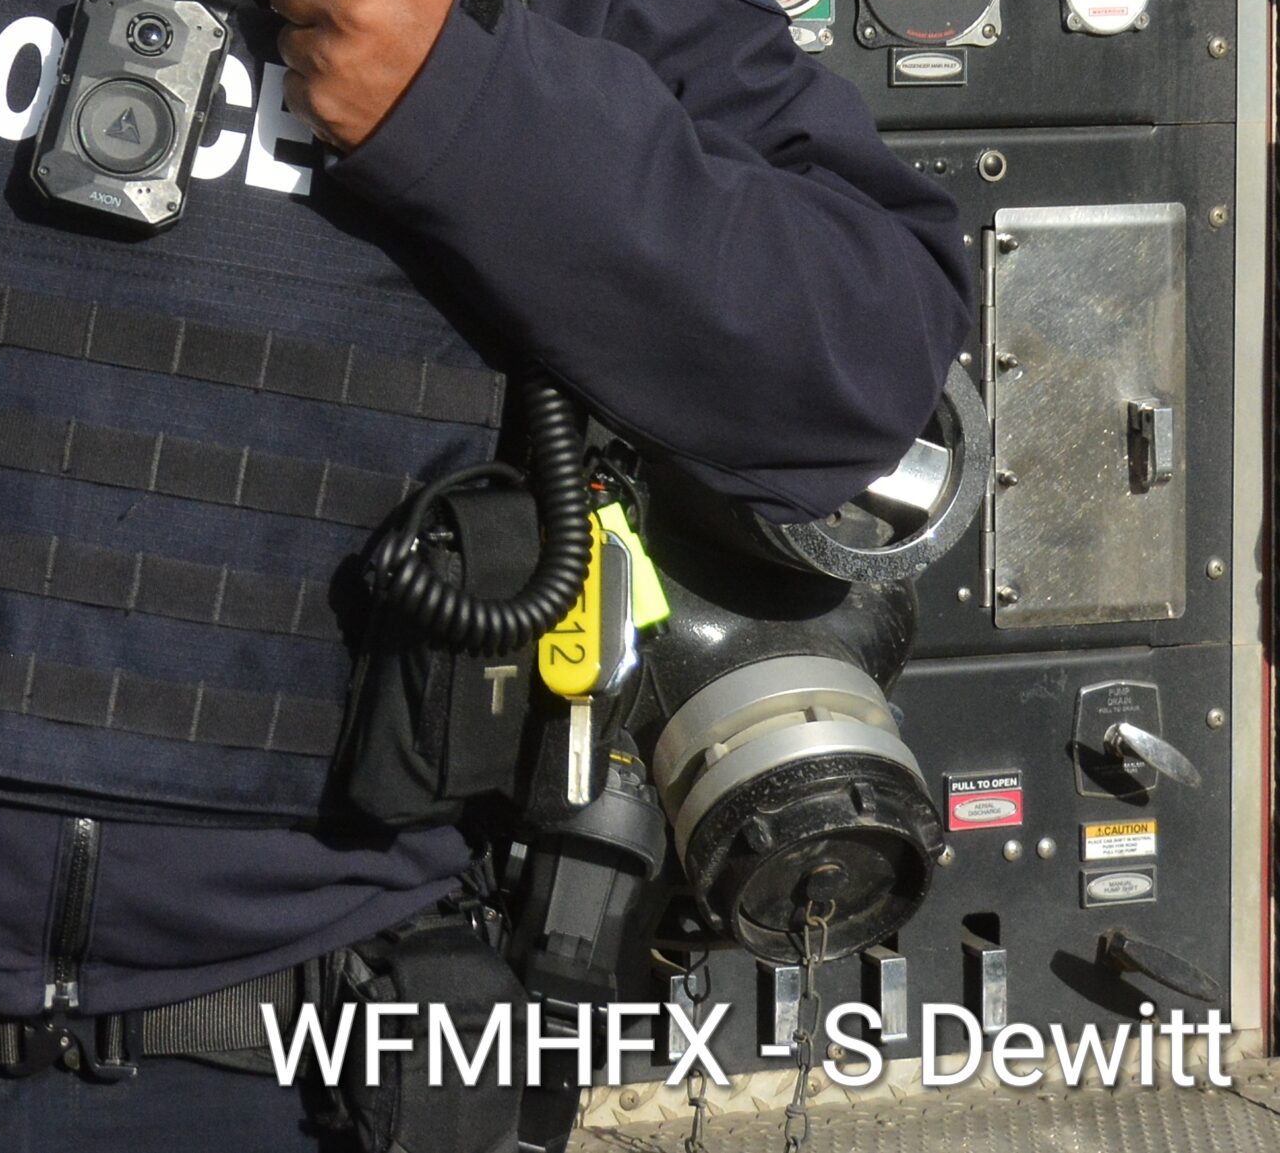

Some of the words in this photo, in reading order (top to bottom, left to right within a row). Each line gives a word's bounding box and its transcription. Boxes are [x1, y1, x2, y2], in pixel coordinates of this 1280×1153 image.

[88, 190, 122, 208] AXON
[1107, 696, 1132, 706] DRAIN
[951, 781, 976, 792] PULL
[977, 780, 990, 789] TO
[991, 777, 1018, 788] OPEN
[967, 809, 1002, 817] DISCHARGE
[1104, 823, 1148, 836] CAUTION
[1108, 879, 1132, 887] MANUAL
[1103, 885, 1122, 894] PUMP
